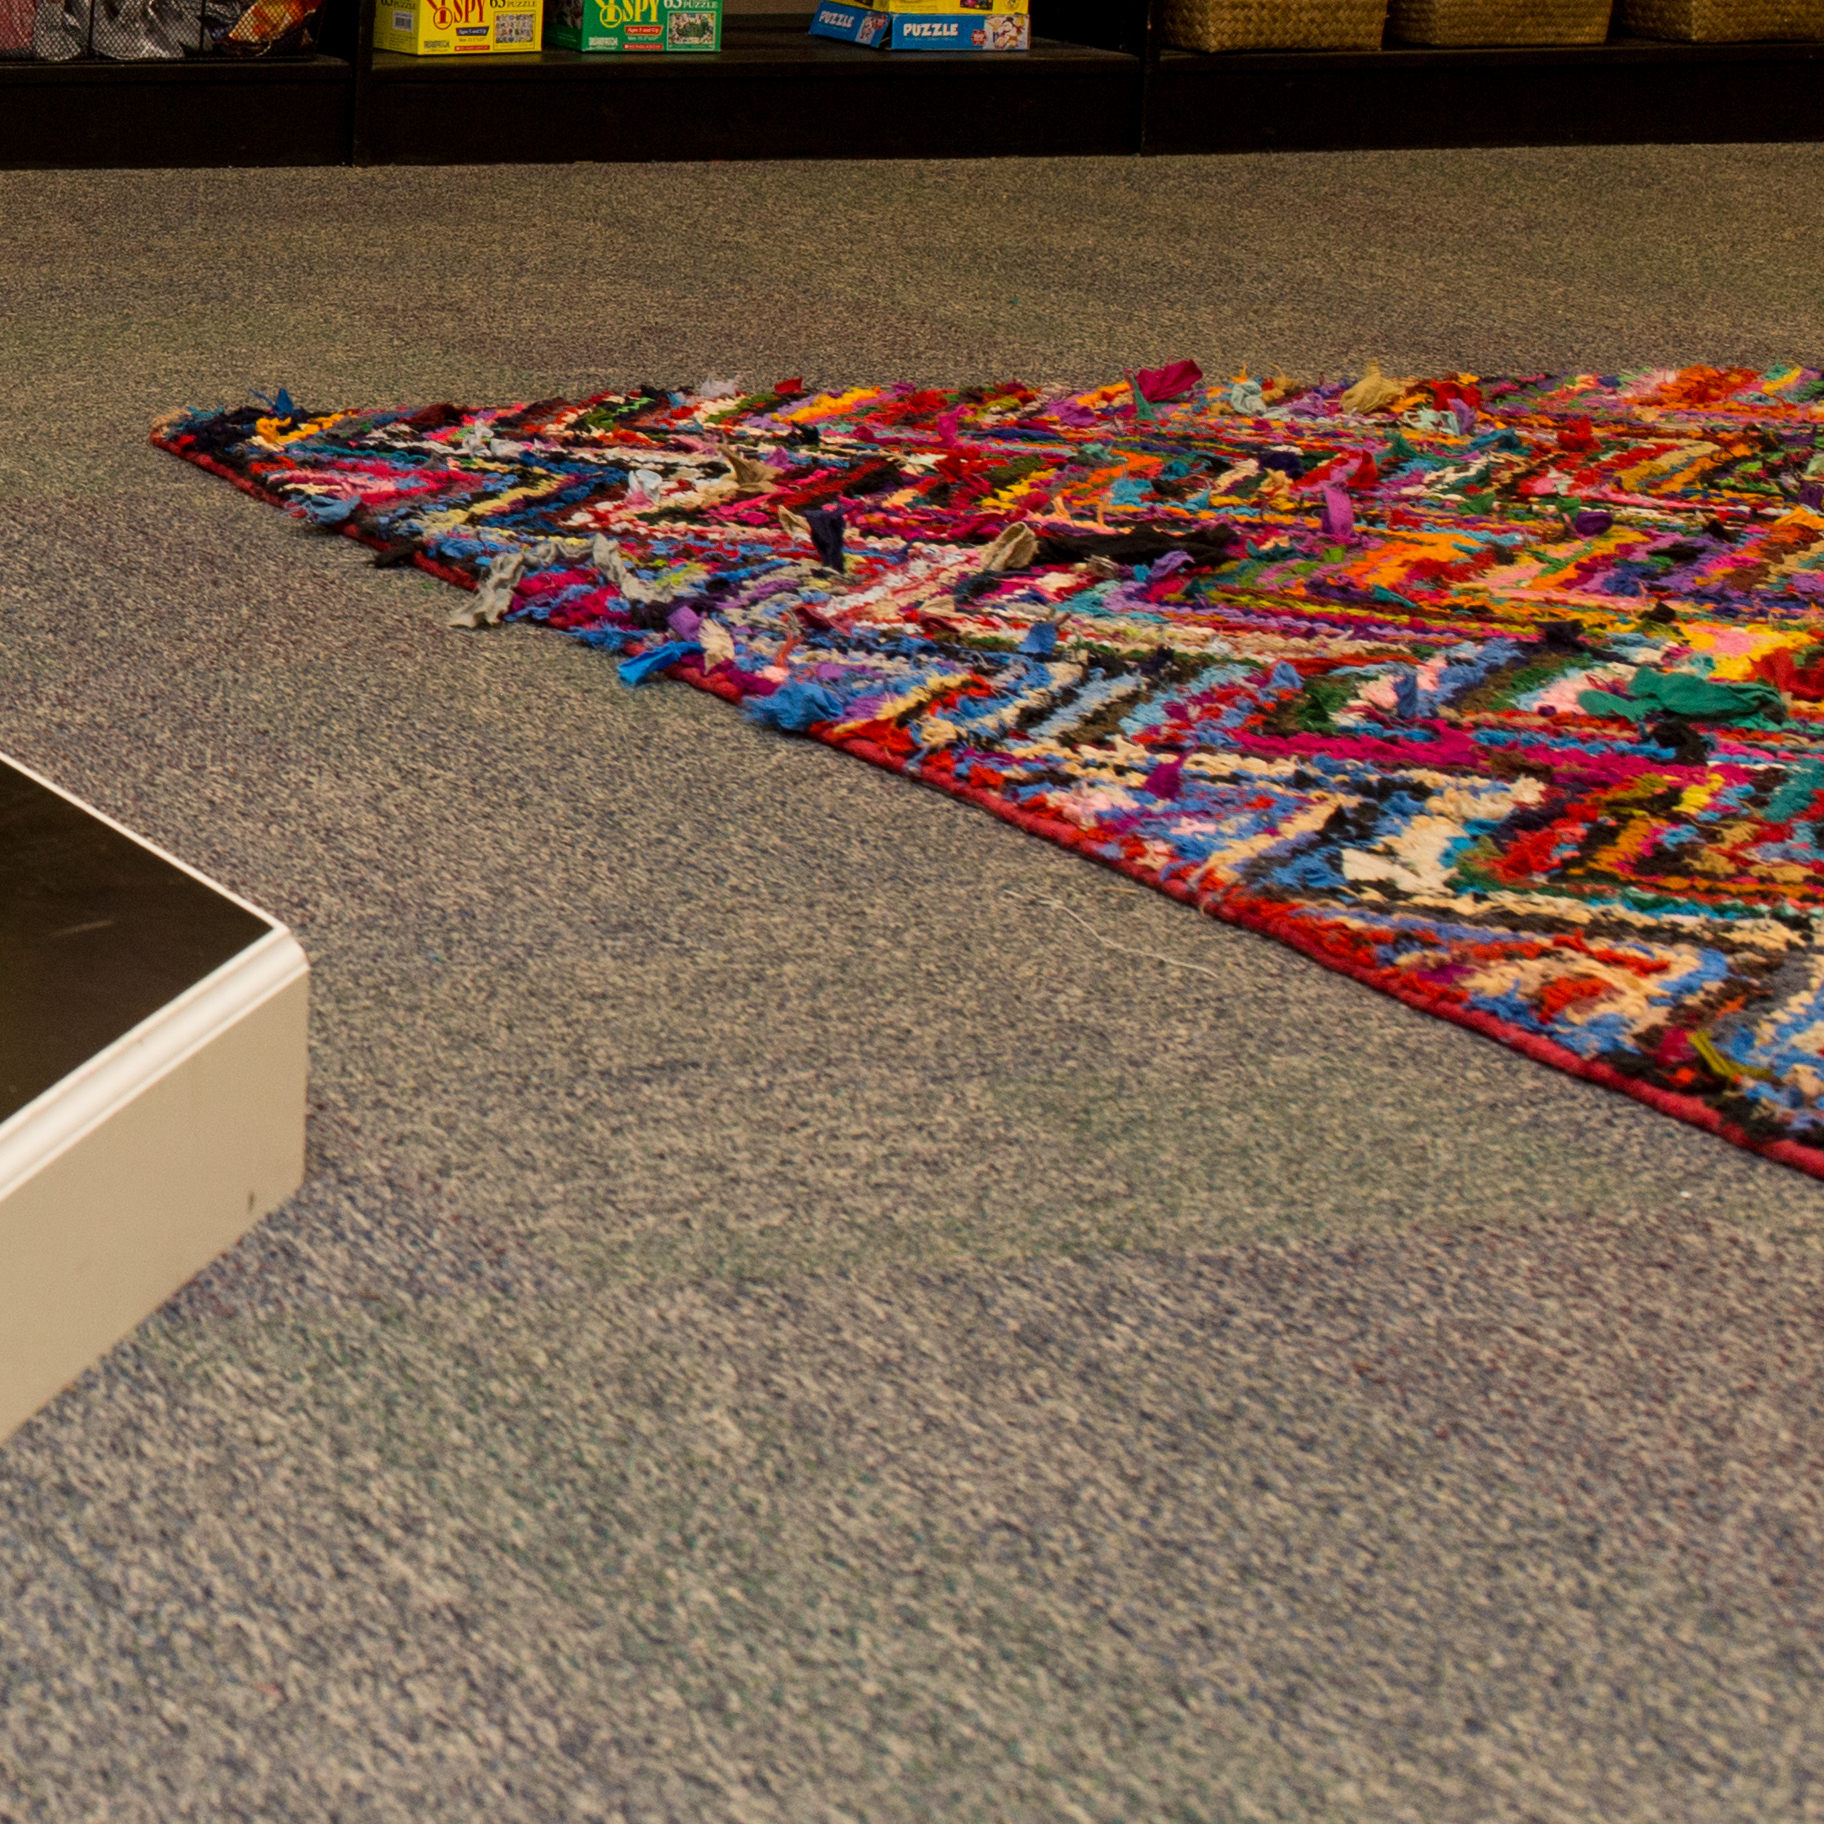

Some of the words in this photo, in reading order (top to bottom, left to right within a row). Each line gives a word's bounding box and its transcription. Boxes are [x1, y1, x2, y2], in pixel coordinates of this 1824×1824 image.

[684, 1, 718, 9] PUZZLE
[819, 10, 855, 29] PUZZLE
[903, 23, 959, 37] PUZZLE
